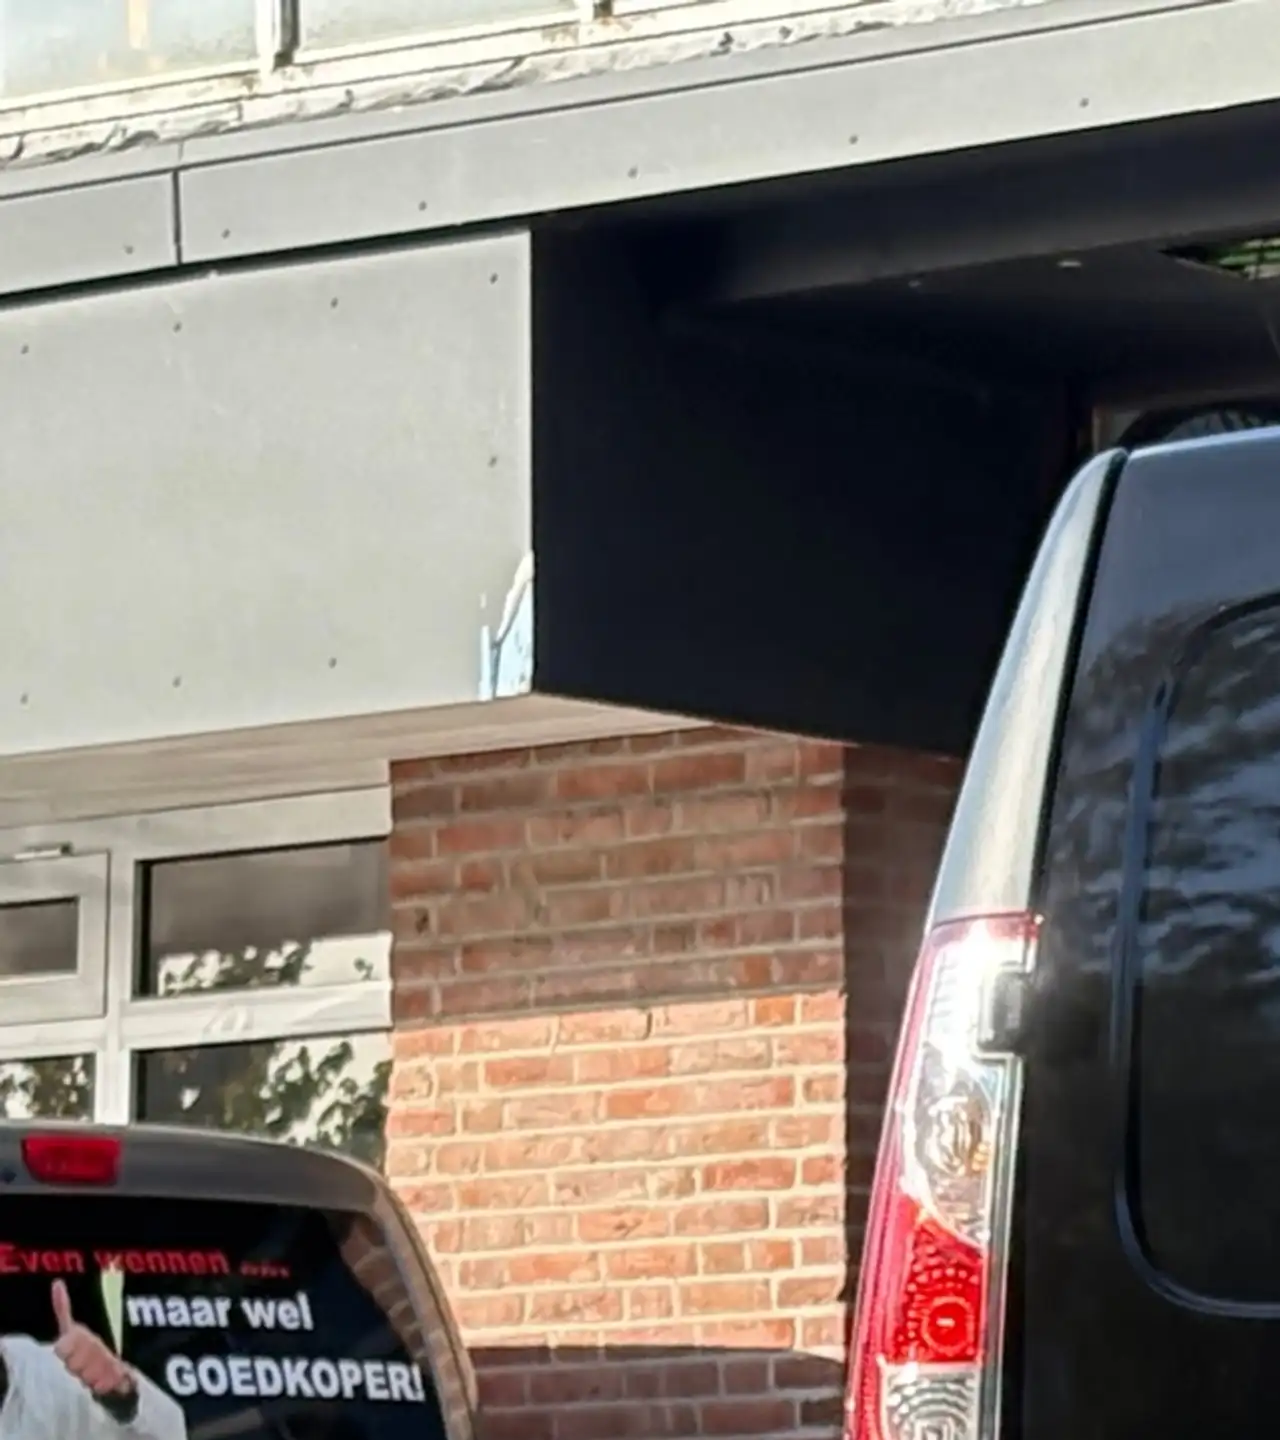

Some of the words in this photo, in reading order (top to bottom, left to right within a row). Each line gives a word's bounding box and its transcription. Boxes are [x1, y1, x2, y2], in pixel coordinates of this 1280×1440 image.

[0, 1242, 84, 1274] Even
[93, 1249, 229, 1274] wennen
[126, 1295, 231, 1328] maar
[240, 1291, 313, 1330] wel
[165, 1354, 425, 1402] GOEDKOPER!
